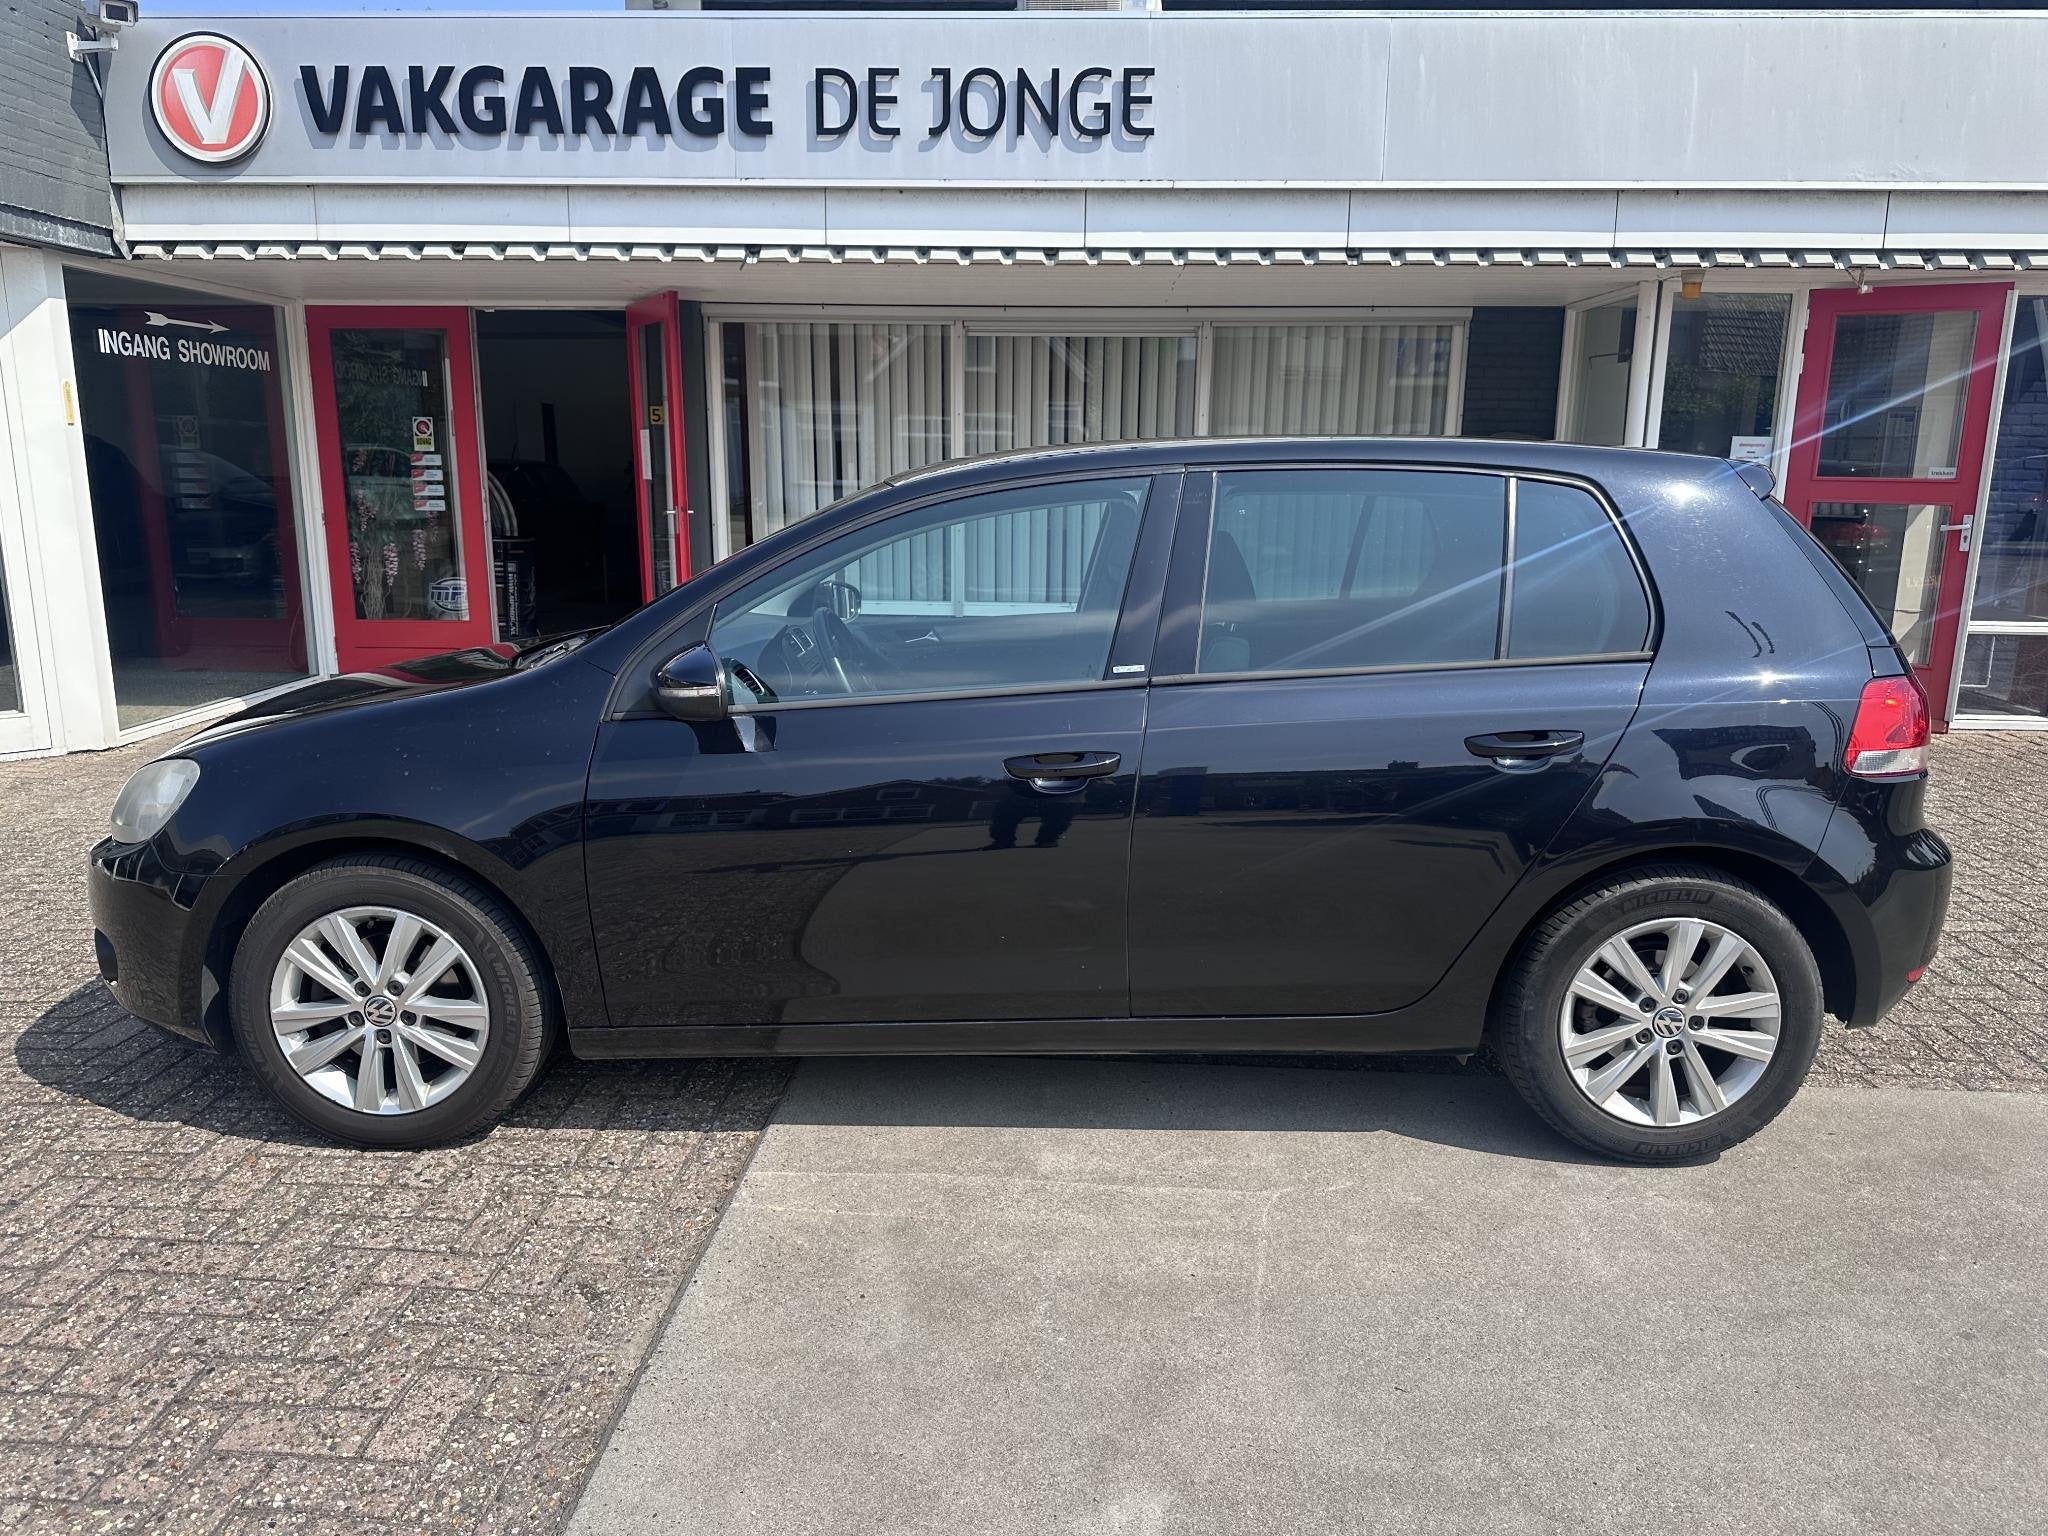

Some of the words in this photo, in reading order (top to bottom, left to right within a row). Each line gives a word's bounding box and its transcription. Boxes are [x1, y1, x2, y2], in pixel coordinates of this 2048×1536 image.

[299, 65, 773, 135] VAKGARAGE
[815, 67, 900, 136] DE
[928, 67, 1156, 137] JONGE
[98, 328, 171, 360] INGANG
[177, 339, 271, 372] SHOWROOM
[652, 408, 661, 422] 5
[1622, 887, 1715, 913] MICHELIN
